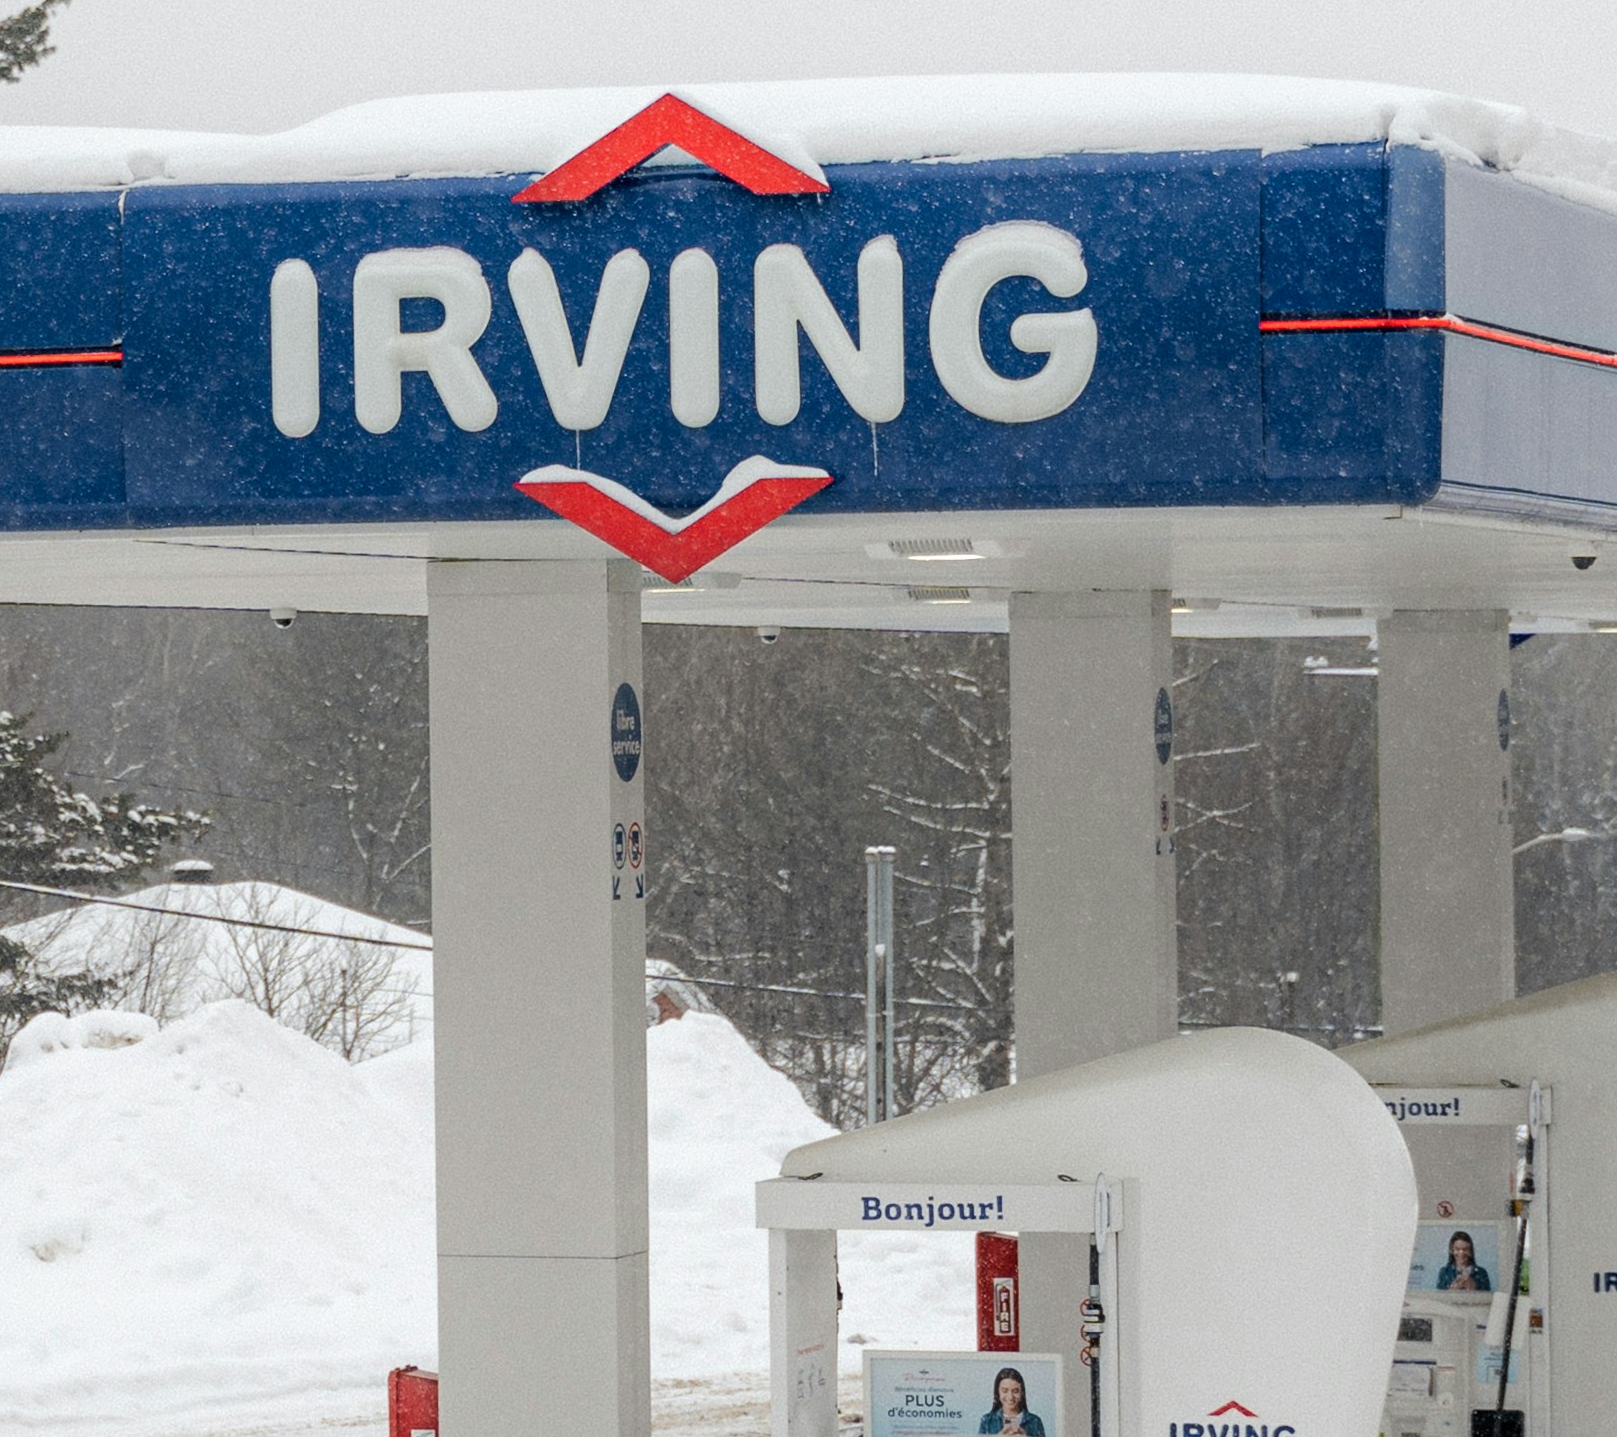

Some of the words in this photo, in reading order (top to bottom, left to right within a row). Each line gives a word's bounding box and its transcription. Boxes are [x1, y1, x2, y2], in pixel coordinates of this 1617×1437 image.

[271, 220, 1098, 438] IRVING
[616, 708, 636, 731] libre
[613, 735, 640, 756] service
[1385, 1096, 1460, 1121] njour!
[861, 1195, 1004, 1227] Bonjour!
[1000, 1292, 1010, 1332] FIRE
[905, 1394, 945, 1407] PLUS
[887, 1407, 963, 1419] d'économies
